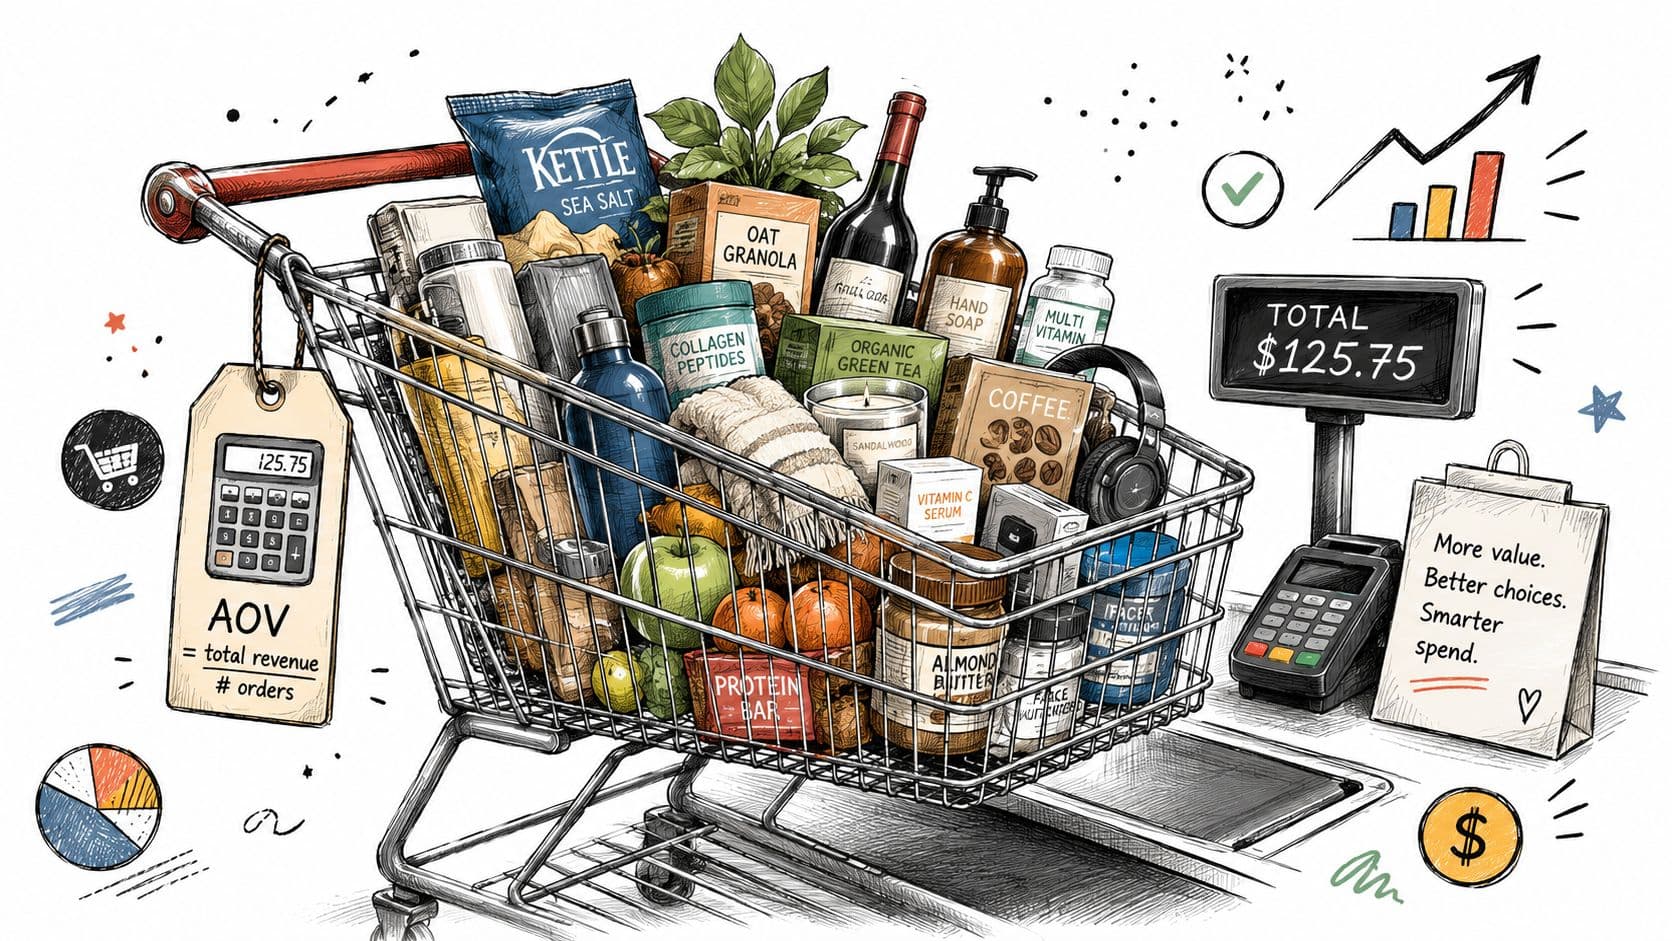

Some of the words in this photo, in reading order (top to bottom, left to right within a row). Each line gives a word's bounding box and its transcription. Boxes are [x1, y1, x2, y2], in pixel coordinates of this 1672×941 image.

[522, 139, 636, 191] KETTLE
[561, 198, 593, 216] SEA
[597, 189, 634, 210] SALT
[747, 225, 780, 245] OAT
[723, 245, 797, 270] GRANOLA
[949, 295, 989, 315] HAND
[1267, 303, 1369, 331] TOTAL
[946, 313, 983, 331] SOAP
[1045, 309, 1084, 329] MULTI
[670, 331, 746, 357] COLLAGEN
[1036, 324, 1086, 345] VITAMIN
[851, 339, 915, 359] ORGANIC
[1253, 332, 1423, 381] $125.75
[677, 350, 746, 375] PEPTIDES
[838, 356, 889, 374] GREEN
[895, 362, 921, 378] TEA
[258, 453, 308, 474] 125.75
[918, 491, 962, 506] VITAMIN
[965, 490, 973, 502] C
[924, 505, 962, 520] SERUM
[1433, 532, 1482, 559] More
[1491, 543, 1546, 569] value.
[1423, 567, 1488, 595] Better
[1493, 579, 1567, 609] choices.
[207, 598, 290, 637] AOV
[1420, 602, 1503, 634] Smarter
[204, 643, 246, 664] total
[253, 651, 319, 672] revenue
[932, 652, 997, 672] ALMOND
[1415, 639, 1478, 664] spend.
[215, 675, 231, 694] #
[238, 678, 294, 701] orders
[714, 675, 799, 696] PROTEIN
[741, 700, 781, 720] BAR
